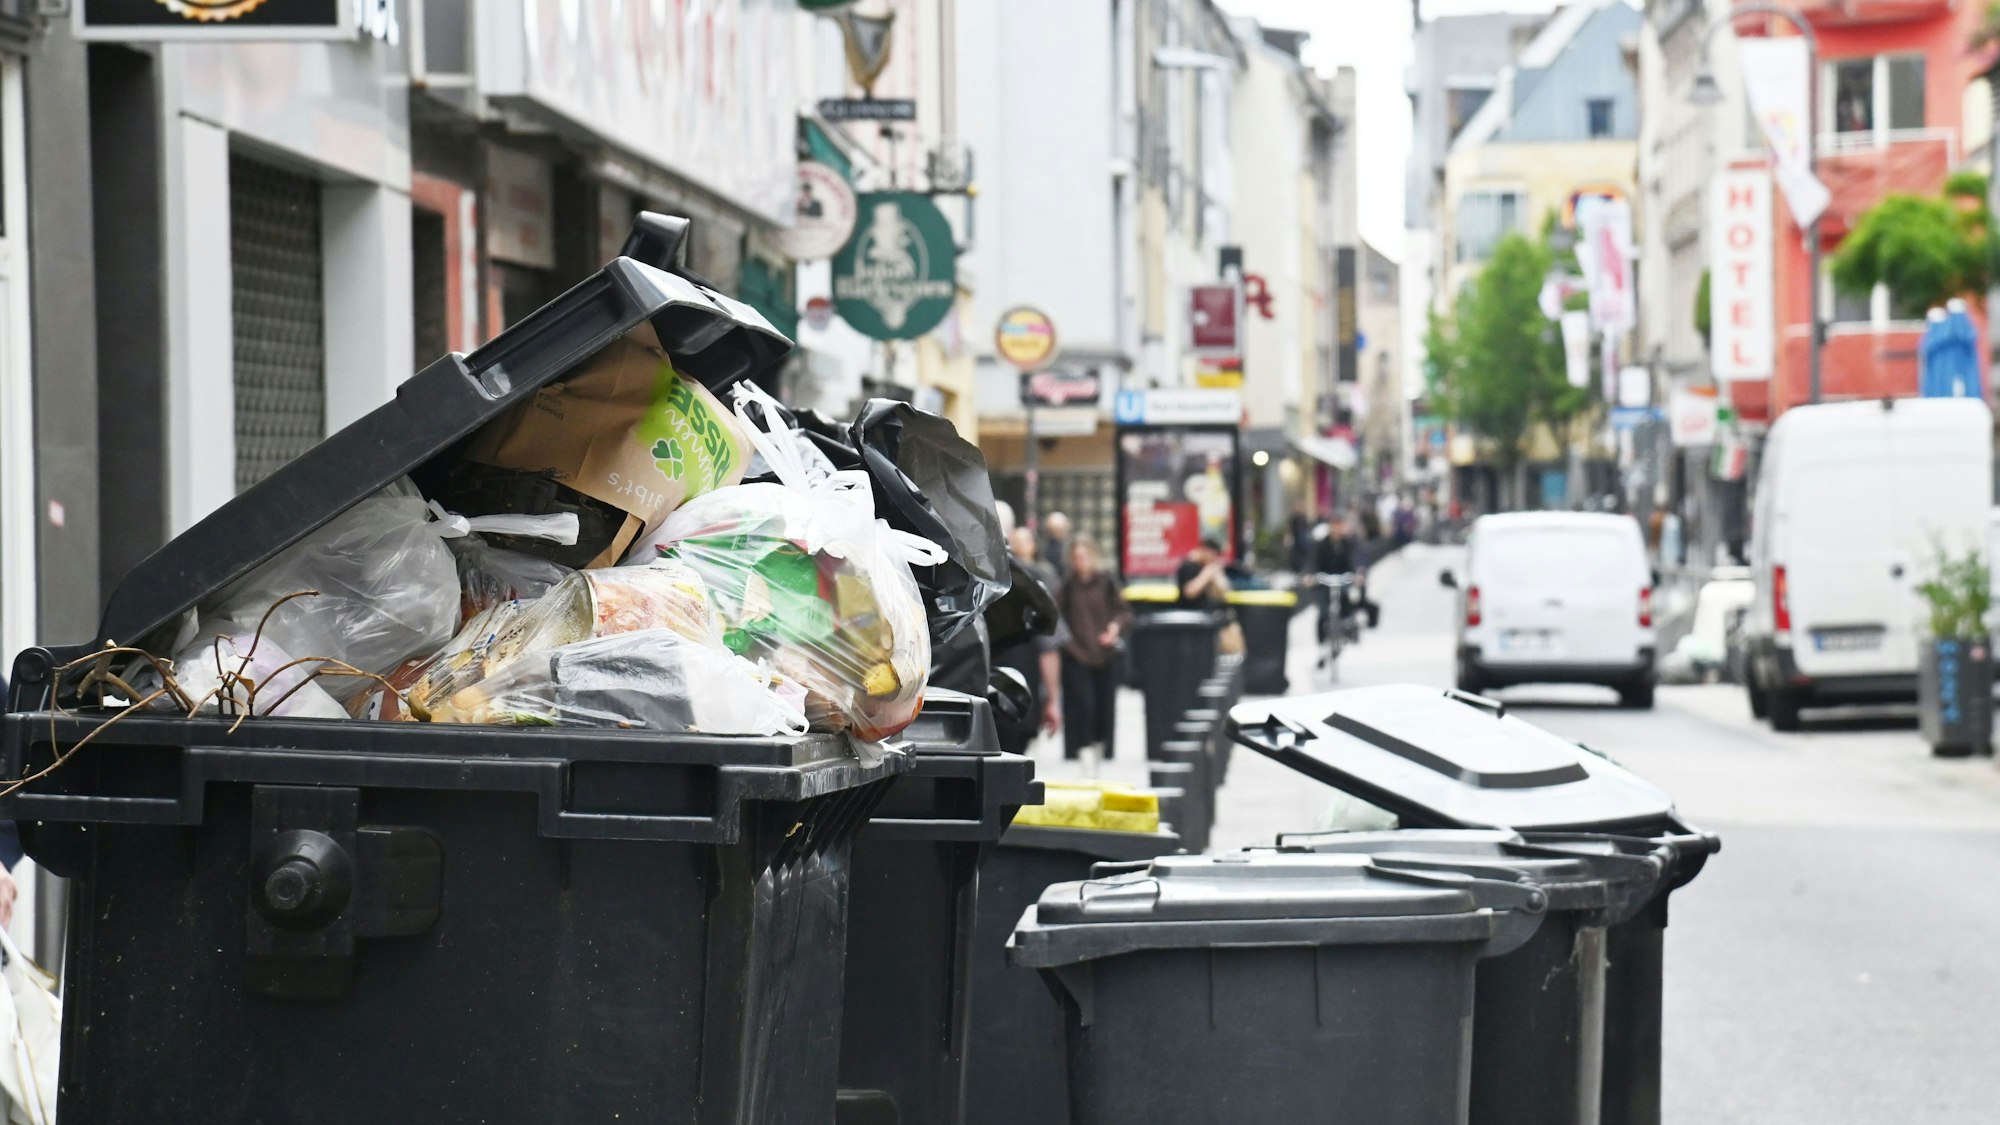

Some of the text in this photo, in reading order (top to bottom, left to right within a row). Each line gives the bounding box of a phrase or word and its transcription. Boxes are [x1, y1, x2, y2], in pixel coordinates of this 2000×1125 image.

[1728, 185, 1754, 367] HOTEL
[668, 377, 730, 489] RISSE
[608, 473, 664, 511] gibt's
